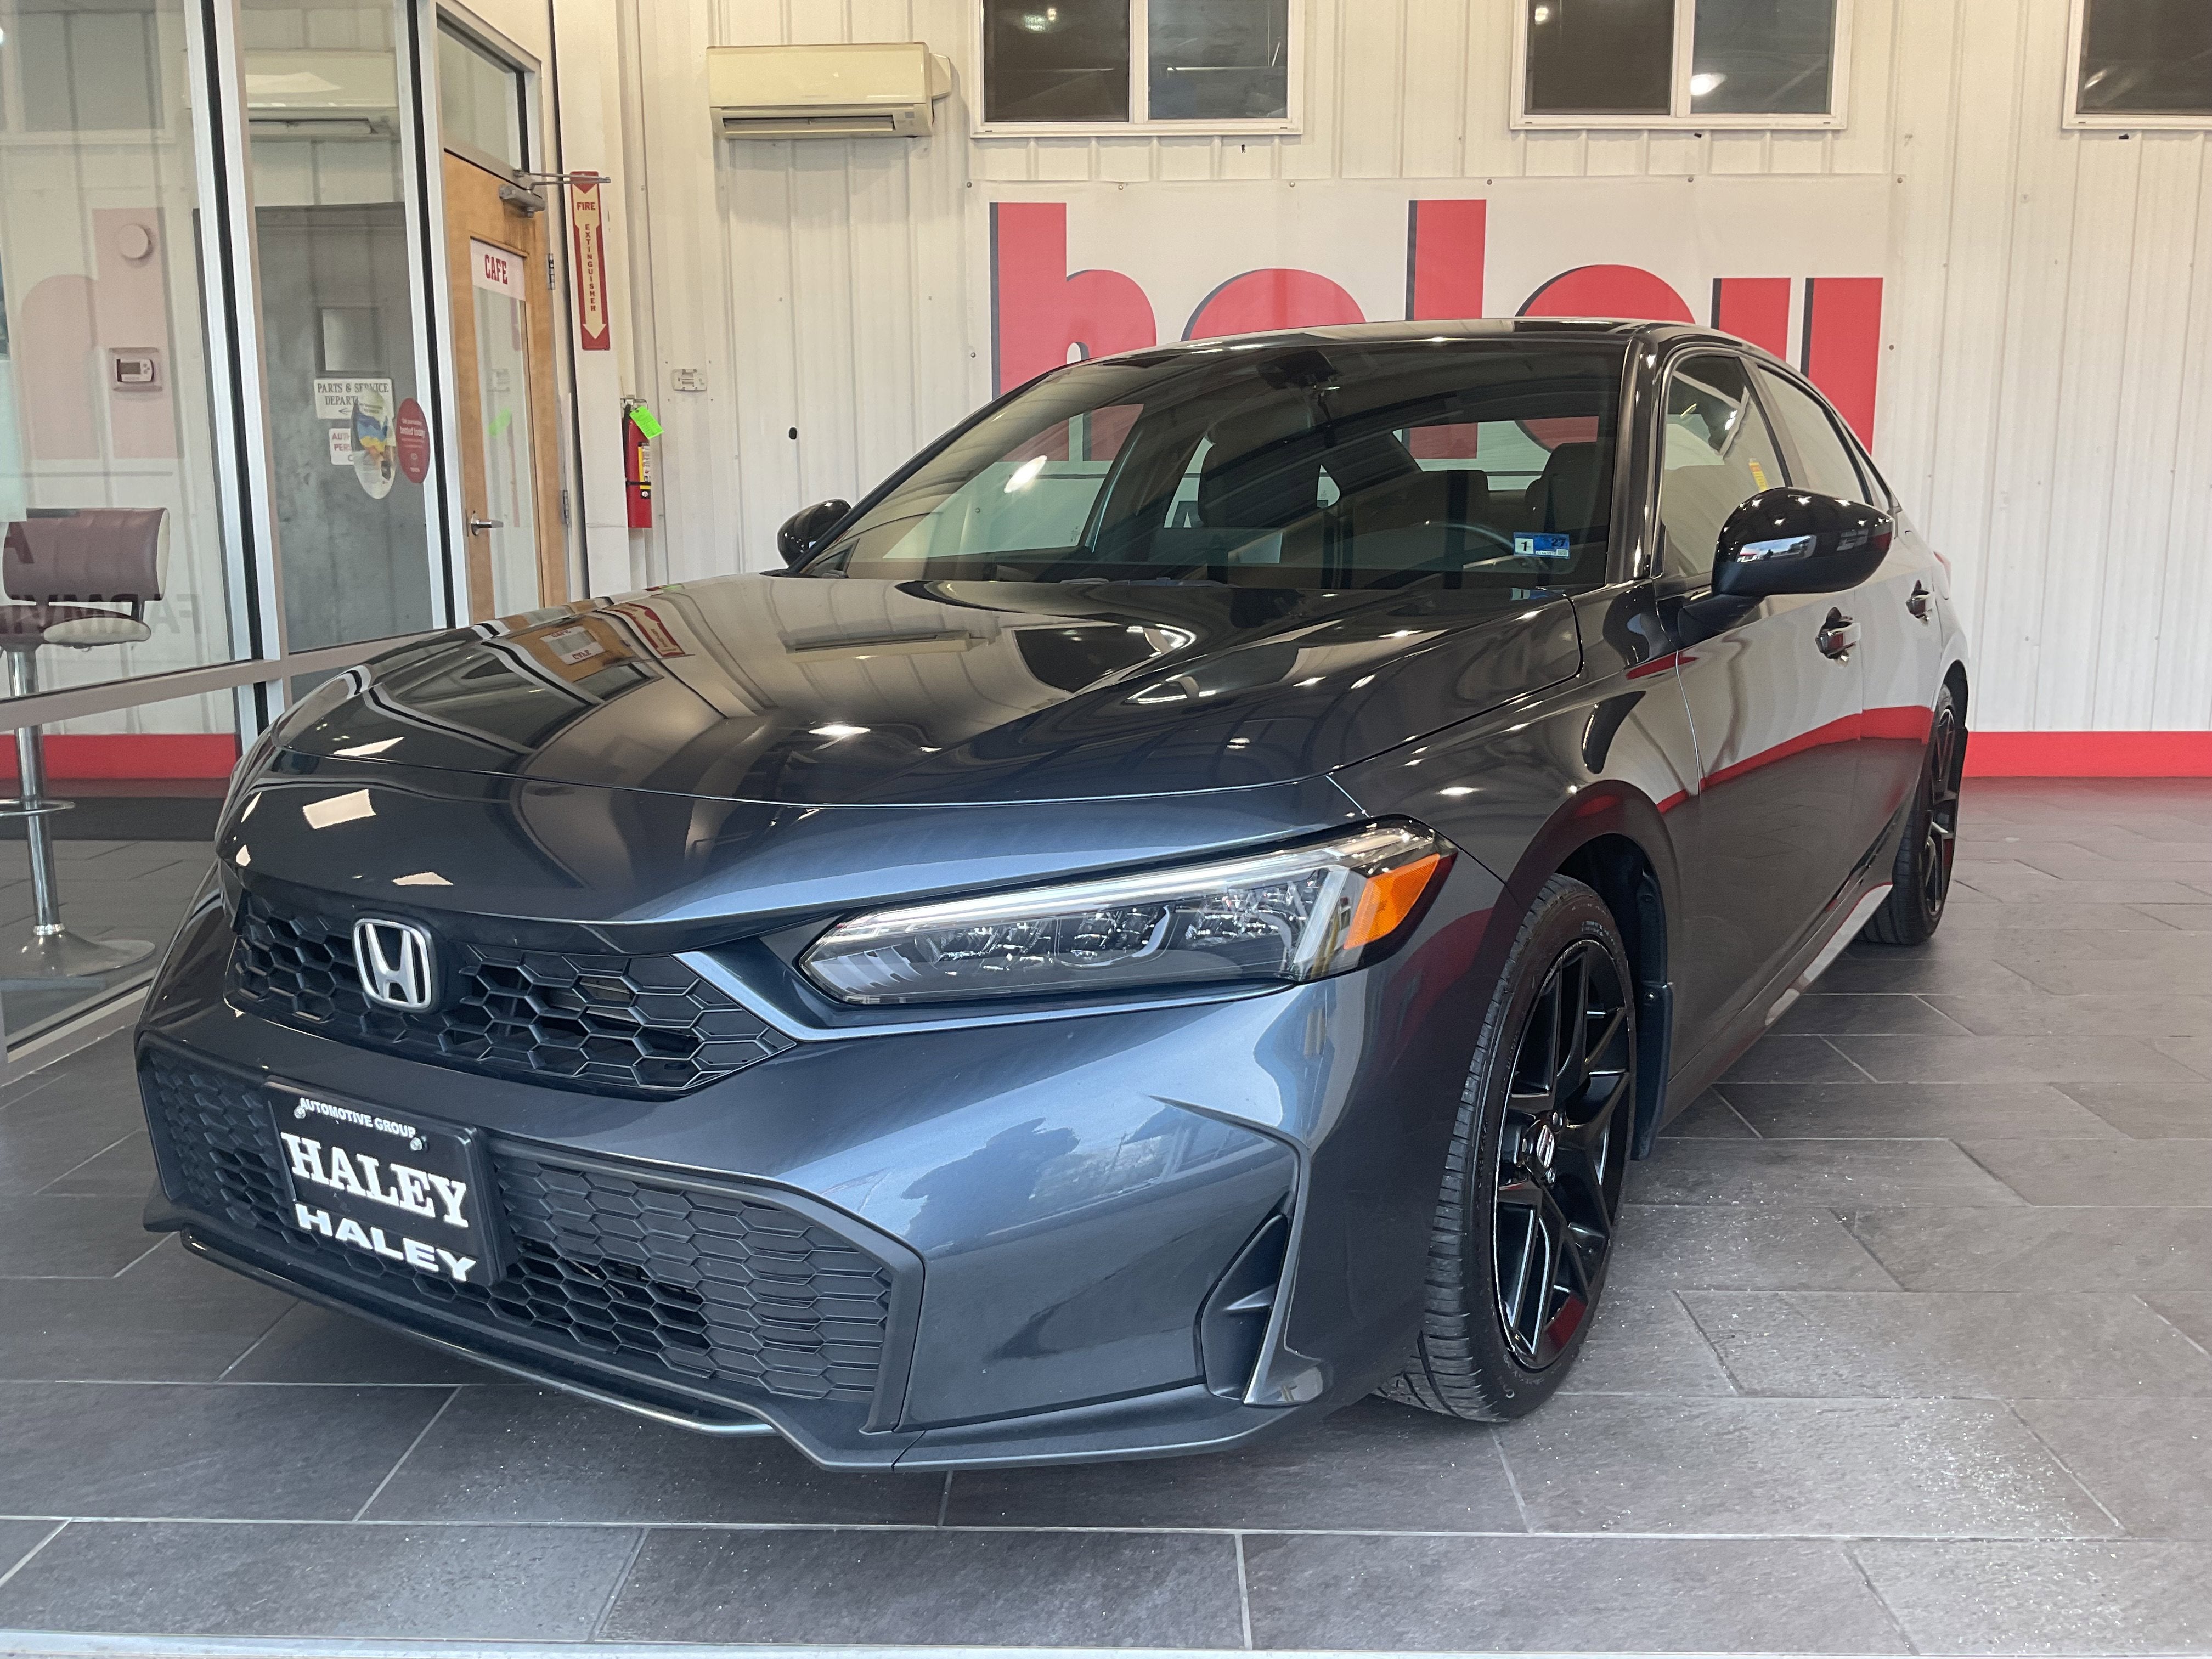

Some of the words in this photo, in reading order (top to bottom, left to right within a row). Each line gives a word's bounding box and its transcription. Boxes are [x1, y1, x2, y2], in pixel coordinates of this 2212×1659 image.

[577, 201, 596, 211] FIRE
[484, 254, 508, 285] CAFE
[585, 224, 596, 311] EXTINGUISHER
[318, 383, 343, 393] PARTS
[325, 395, 359, 405] DEPART
[1521, 541, 1527, 551] 1
[300, 1097, 373, 1128] AUTOMOTIVE
[375, 1117, 417, 1138] GROUP
[280, 1132, 469, 1228] HALEY
[295, 1203, 476, 1282] HALEY
